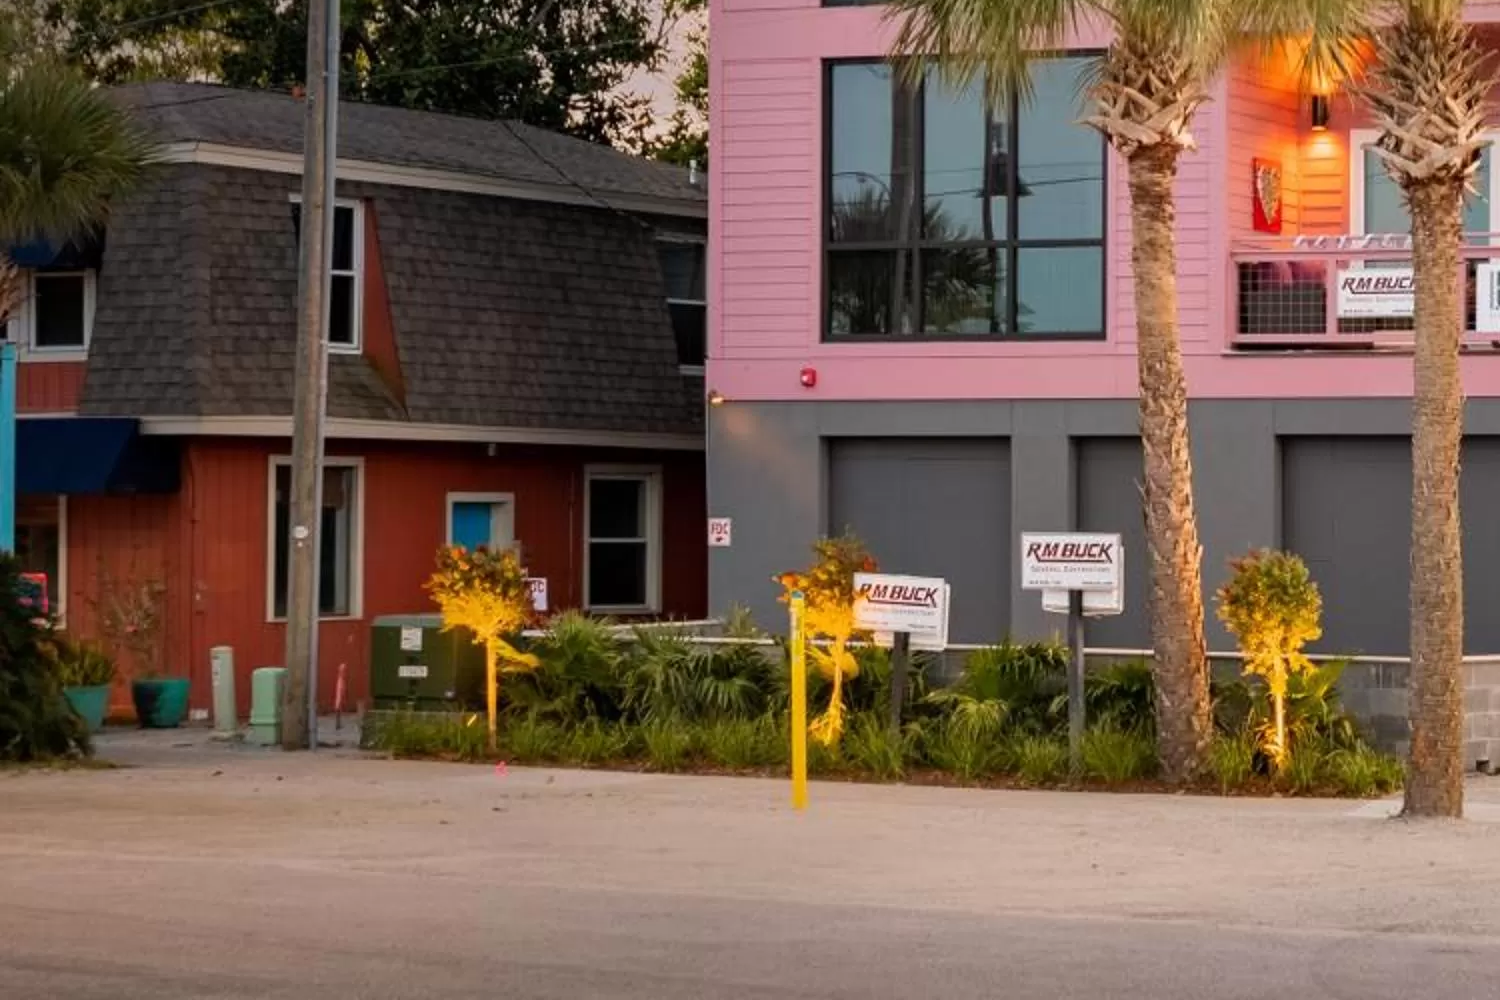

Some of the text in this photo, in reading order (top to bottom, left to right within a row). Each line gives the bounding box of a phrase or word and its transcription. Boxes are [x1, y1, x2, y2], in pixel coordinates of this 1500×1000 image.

[1027, 543, 1113, 563] RM BUCK
[889, 585, 939, 607] BUCK
